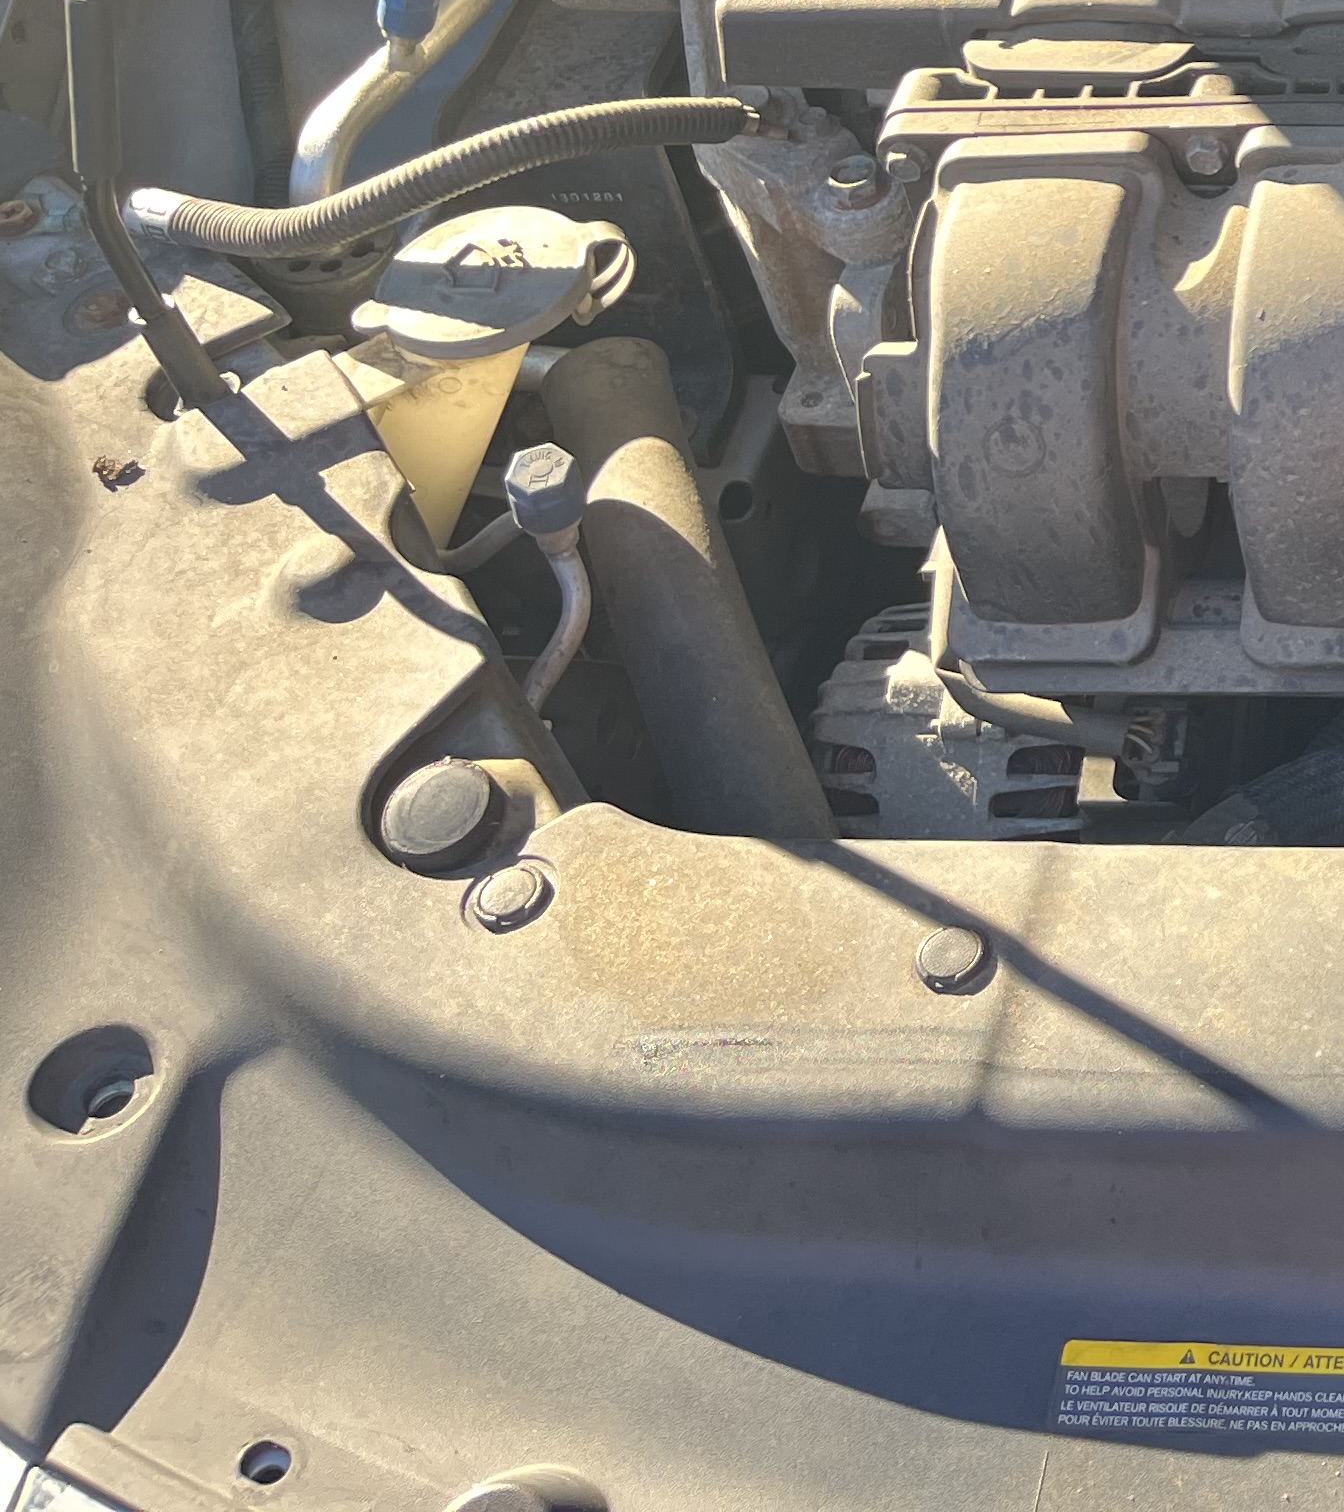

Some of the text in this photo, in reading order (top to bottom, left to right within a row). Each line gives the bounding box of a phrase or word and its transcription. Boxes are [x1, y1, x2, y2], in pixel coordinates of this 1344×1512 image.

[1208, 1351, 1285, 1368] CAUTION
[1066, 1370, 1255, 1386] FAN BLADE CAN START AT ANY TIME.
[1065, 1384, 1080, 1395] TO
[1081, 1385, 1111, 1396] HELP
[1111, 1386, 1145, 1396] AVOID
[1147, 1387, 1203, 1398] PERSONAL
[1274, 1391, 1313, 1403] HANDS
[1060, 1400, 1075, 1411] LE
[1077, 1401, 1146, 1413] VENTILATEUR
[1148, 1402, 1189, 1413] RISQUE
[1191, 1403, 1206, 1414] DE
[1208, 1402, 1270, 1417] DÉMARRER
[1270, 1404, 1278, 1417] À
[1281, 1406, 1308, 1418] TOUT
[1057, 1414, 1090, 1426] POUR
[1092, 1412, 1128, 1426] ÉVITER
[1131, 1416, 1166, 1427] TOUTE
[1168, 1417, 1227, 1430] BLESSURE,
[1229, 1419, 1244, 1430] NE
[1247, 1420, 1268, 1431] PAS
[1270, 1421, 1286, 1432] EN
